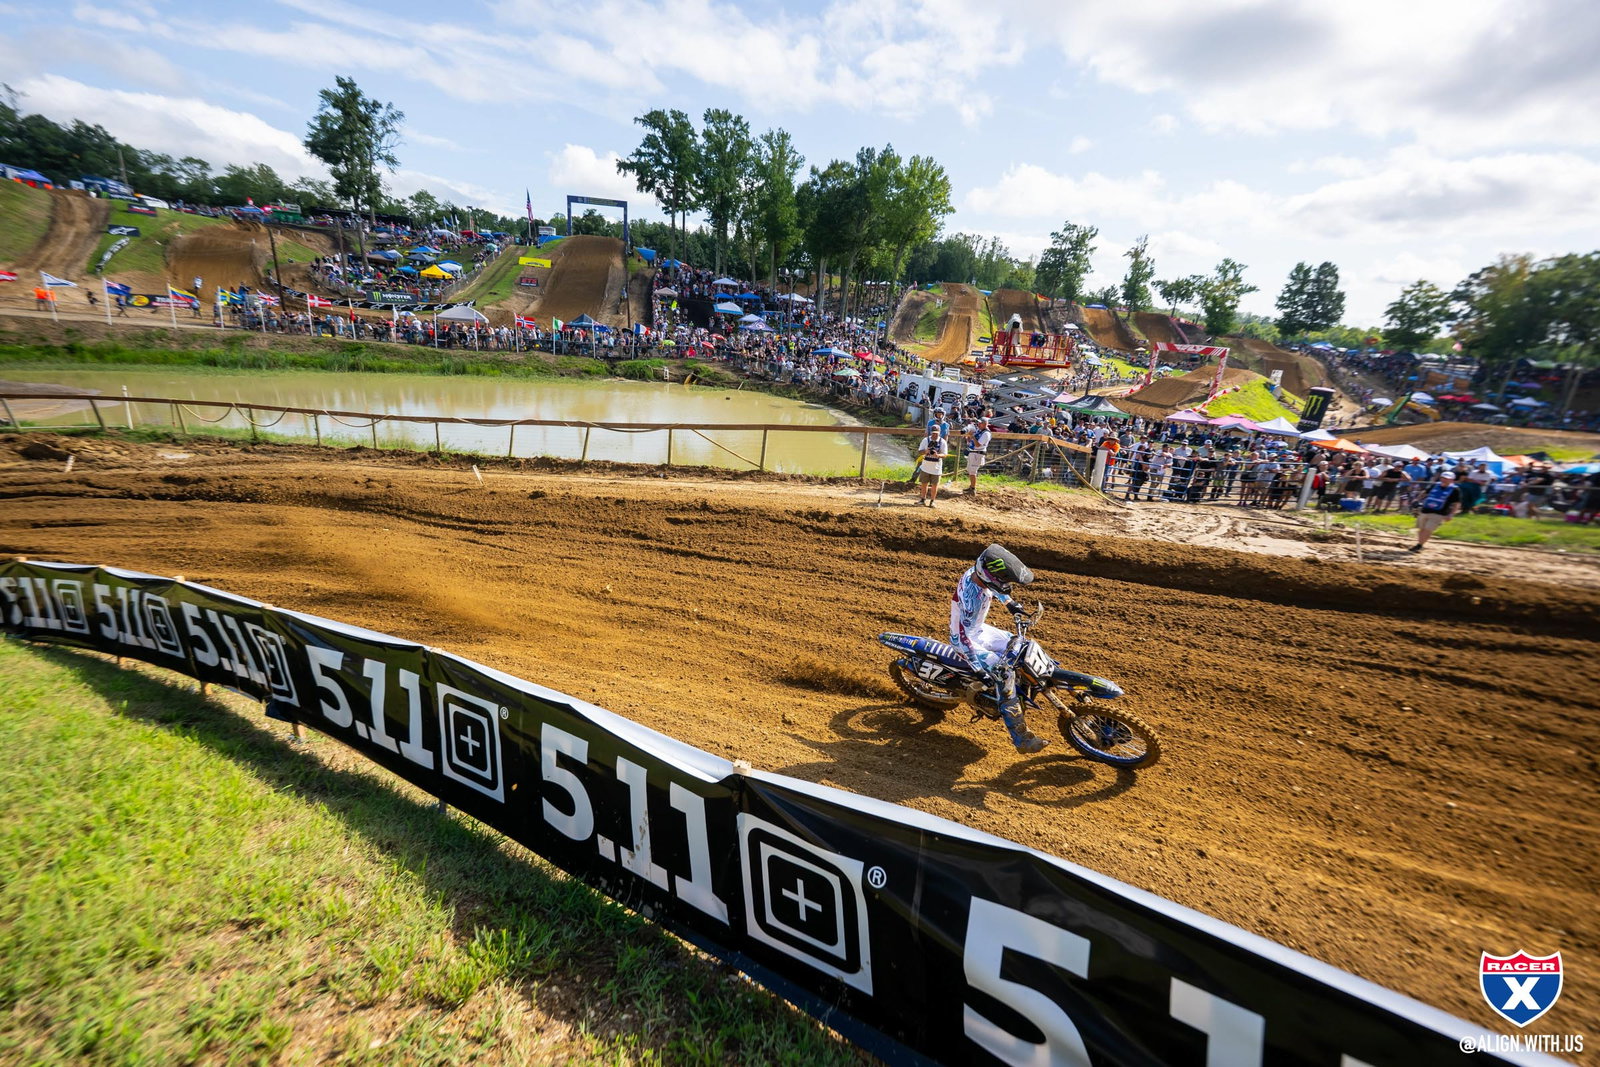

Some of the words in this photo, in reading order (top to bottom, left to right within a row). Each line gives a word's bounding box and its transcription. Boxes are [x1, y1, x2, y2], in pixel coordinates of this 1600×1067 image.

[93, 584, 156, 649] 5.11
[180, 601, 269, 686] 5.11
[305, 645, 434, 769] 5.11
[918, 661, 943, 680] 37
[540, 722, 730, 926] 5.11
